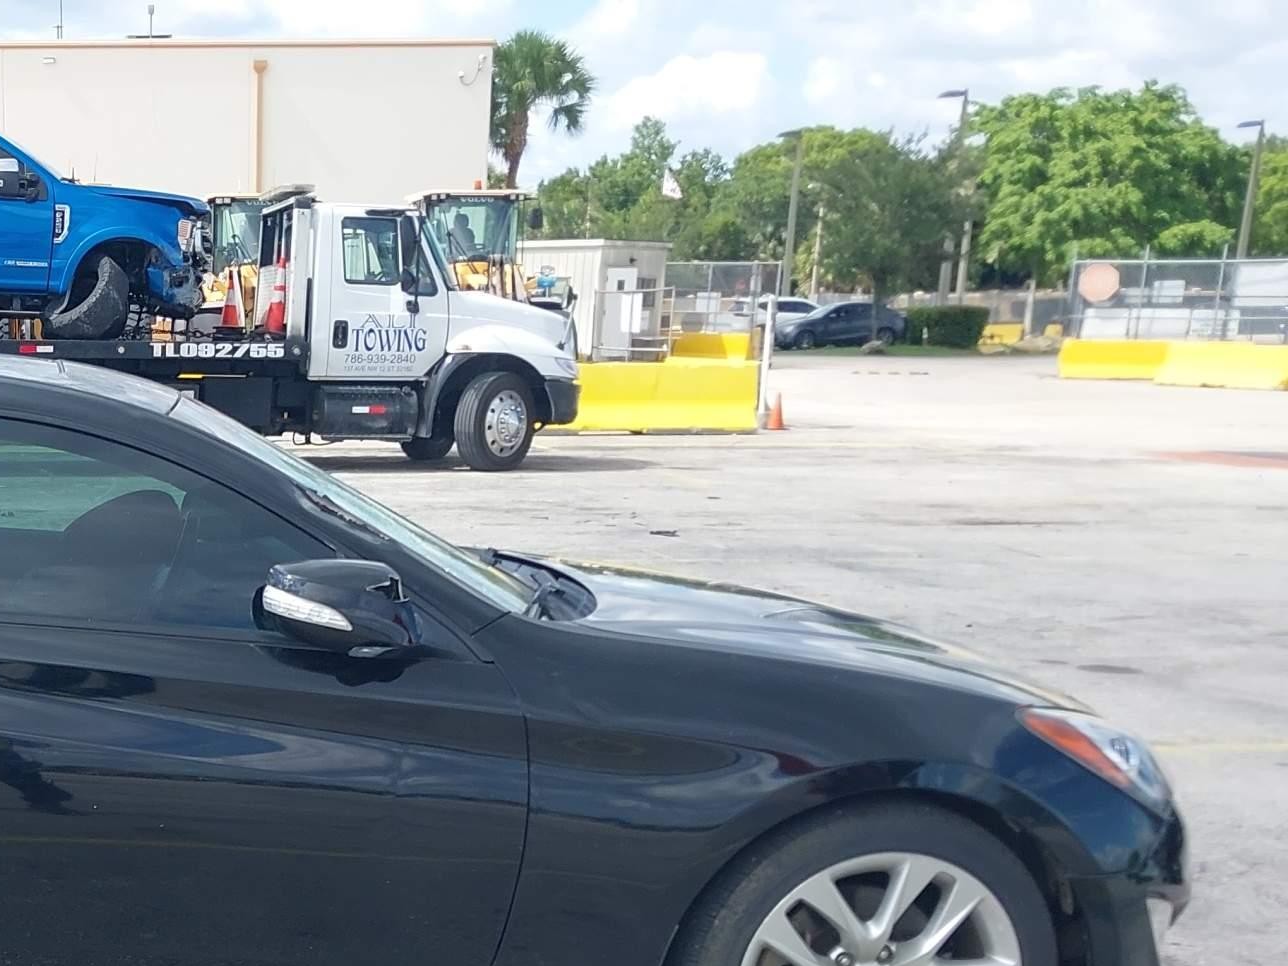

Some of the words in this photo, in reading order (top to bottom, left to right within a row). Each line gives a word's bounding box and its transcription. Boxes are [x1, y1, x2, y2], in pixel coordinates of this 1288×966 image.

[360, 313, 416, 329] ALI
[352, 328, 427, 352] TOWING
[149, 342, 285, 358] TL092755
[344, 354, 416, 364] 786-939-2840
